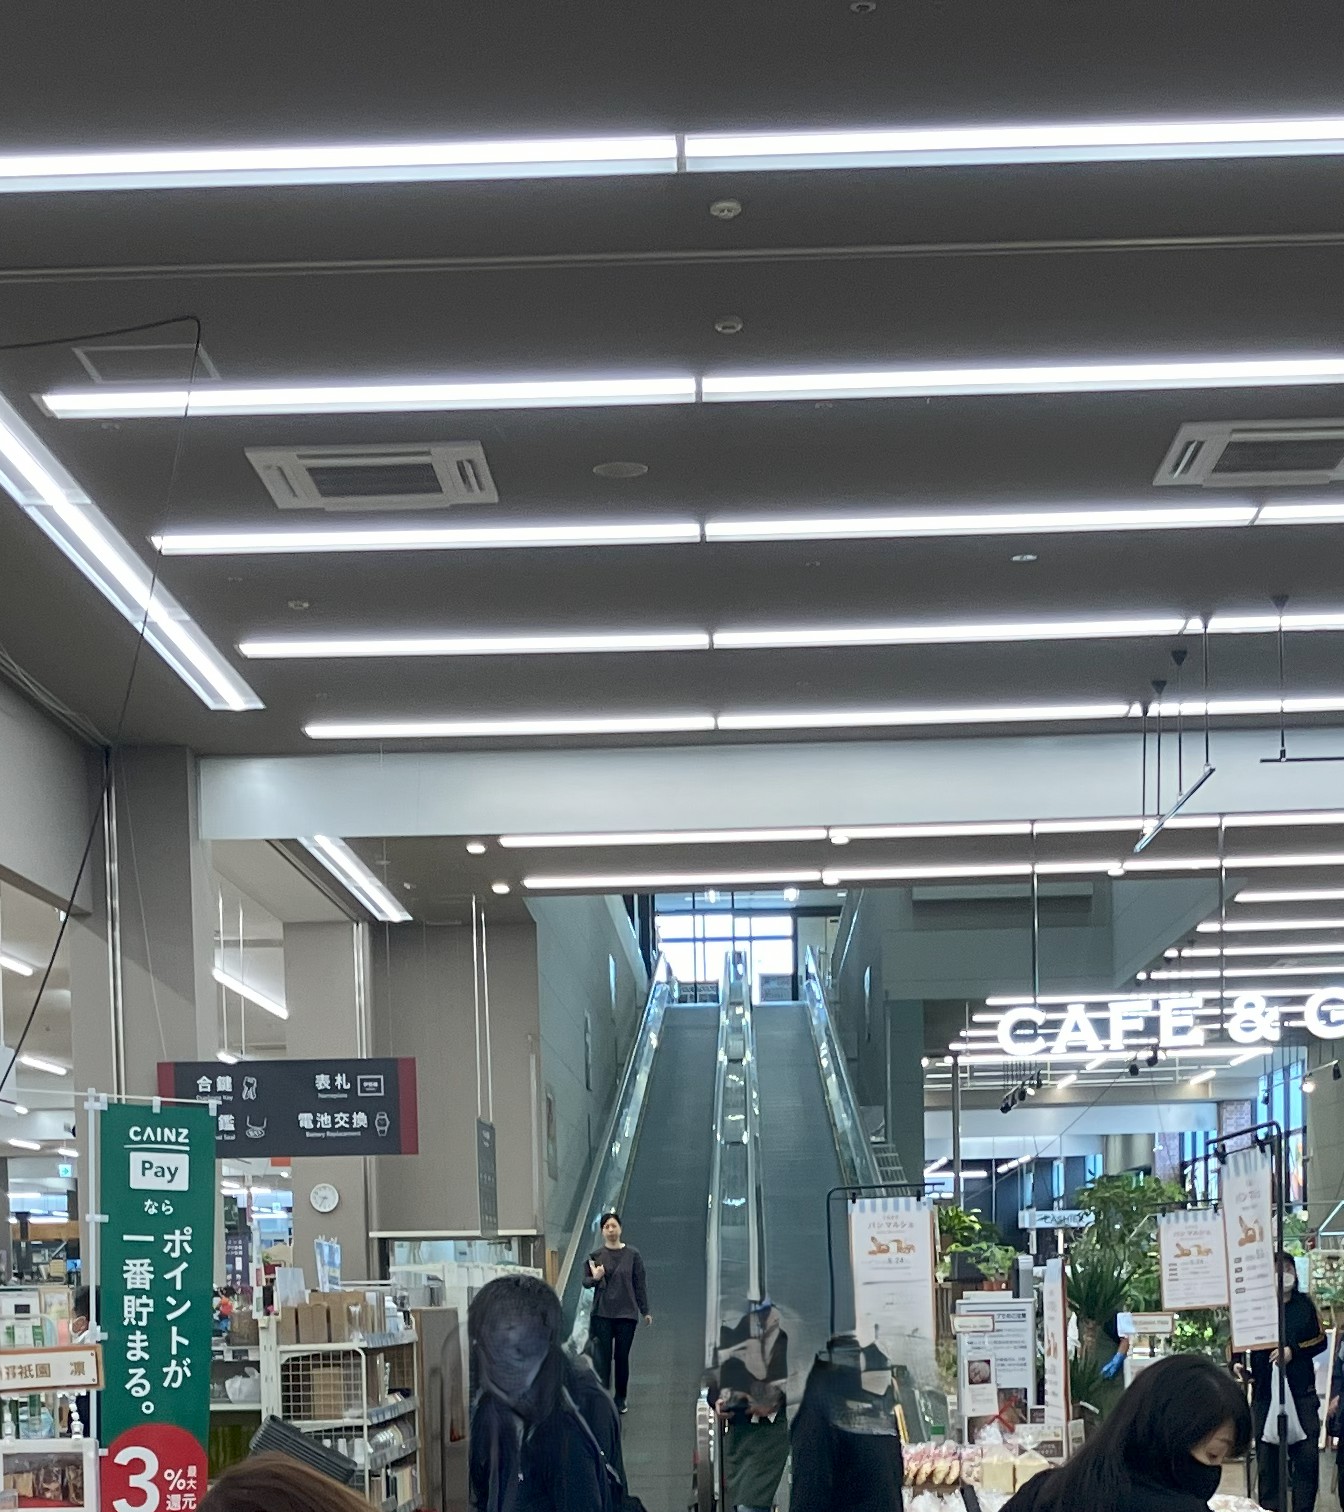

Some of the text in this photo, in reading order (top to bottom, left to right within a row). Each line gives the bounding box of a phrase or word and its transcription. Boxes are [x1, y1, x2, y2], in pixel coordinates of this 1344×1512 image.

[997, 997, 1206, 1056] CAFE
[1228, 989, 1281, 1043] &
[196, 1075, 233, 1093] 合鍵
[315, 1073, 351, 1091] 表札
[218, 1114, 236, 1132] 鑑
[298, 1111, 368, 1129] 電池交換
[129, 1126, 190, 1143] CAINZ
[141, 1160, 179, 1184] Pay
[144, 1199, 174, 1215] なら
[163, 1226, 193, 1389] ポイントが
[122, 1234, 155, 1415] 一番貯まる。
[166, 1493, 197, 1511] 還元
